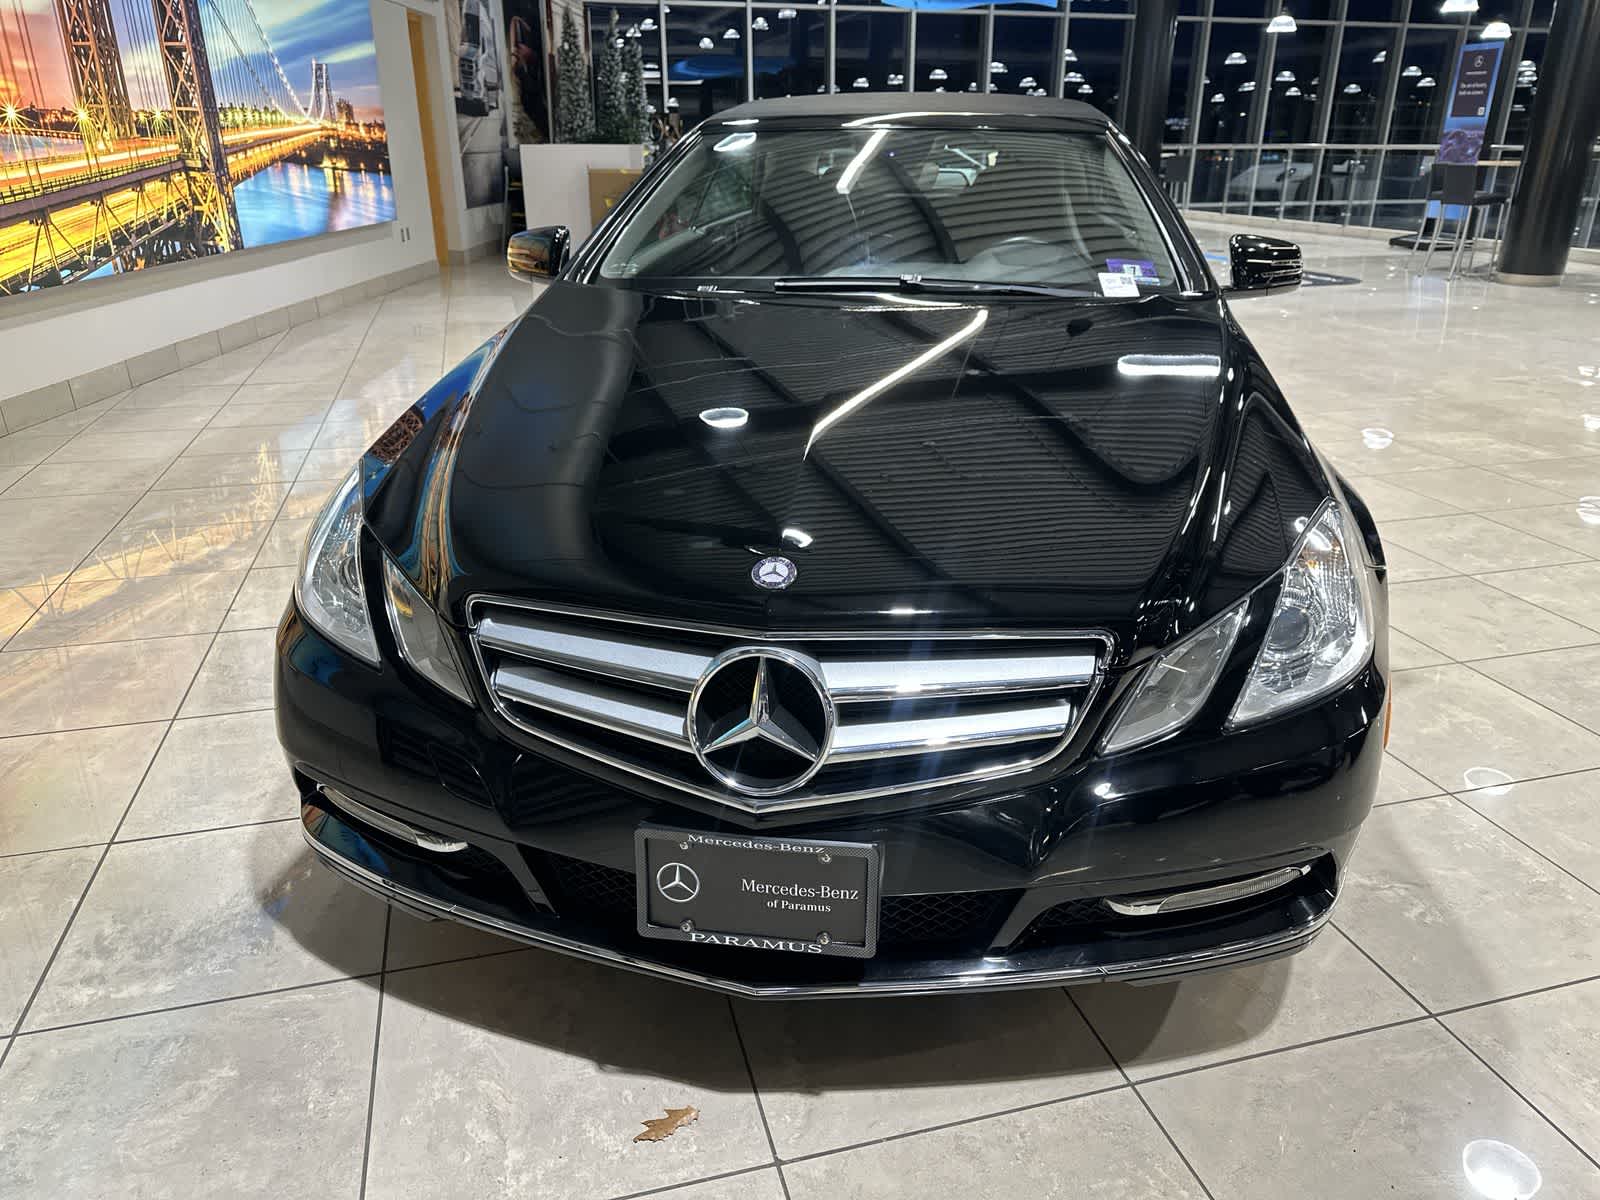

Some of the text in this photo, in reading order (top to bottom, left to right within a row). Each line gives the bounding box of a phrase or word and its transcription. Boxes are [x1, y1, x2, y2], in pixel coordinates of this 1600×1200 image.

[687, 834, 825, 854] Mercedes-Benz
[741, 878, 859, 900] Mercedes-Benz
[767, 899, 831, 913] of Paramus
[689, 933, 822, 954] PARAMUS
